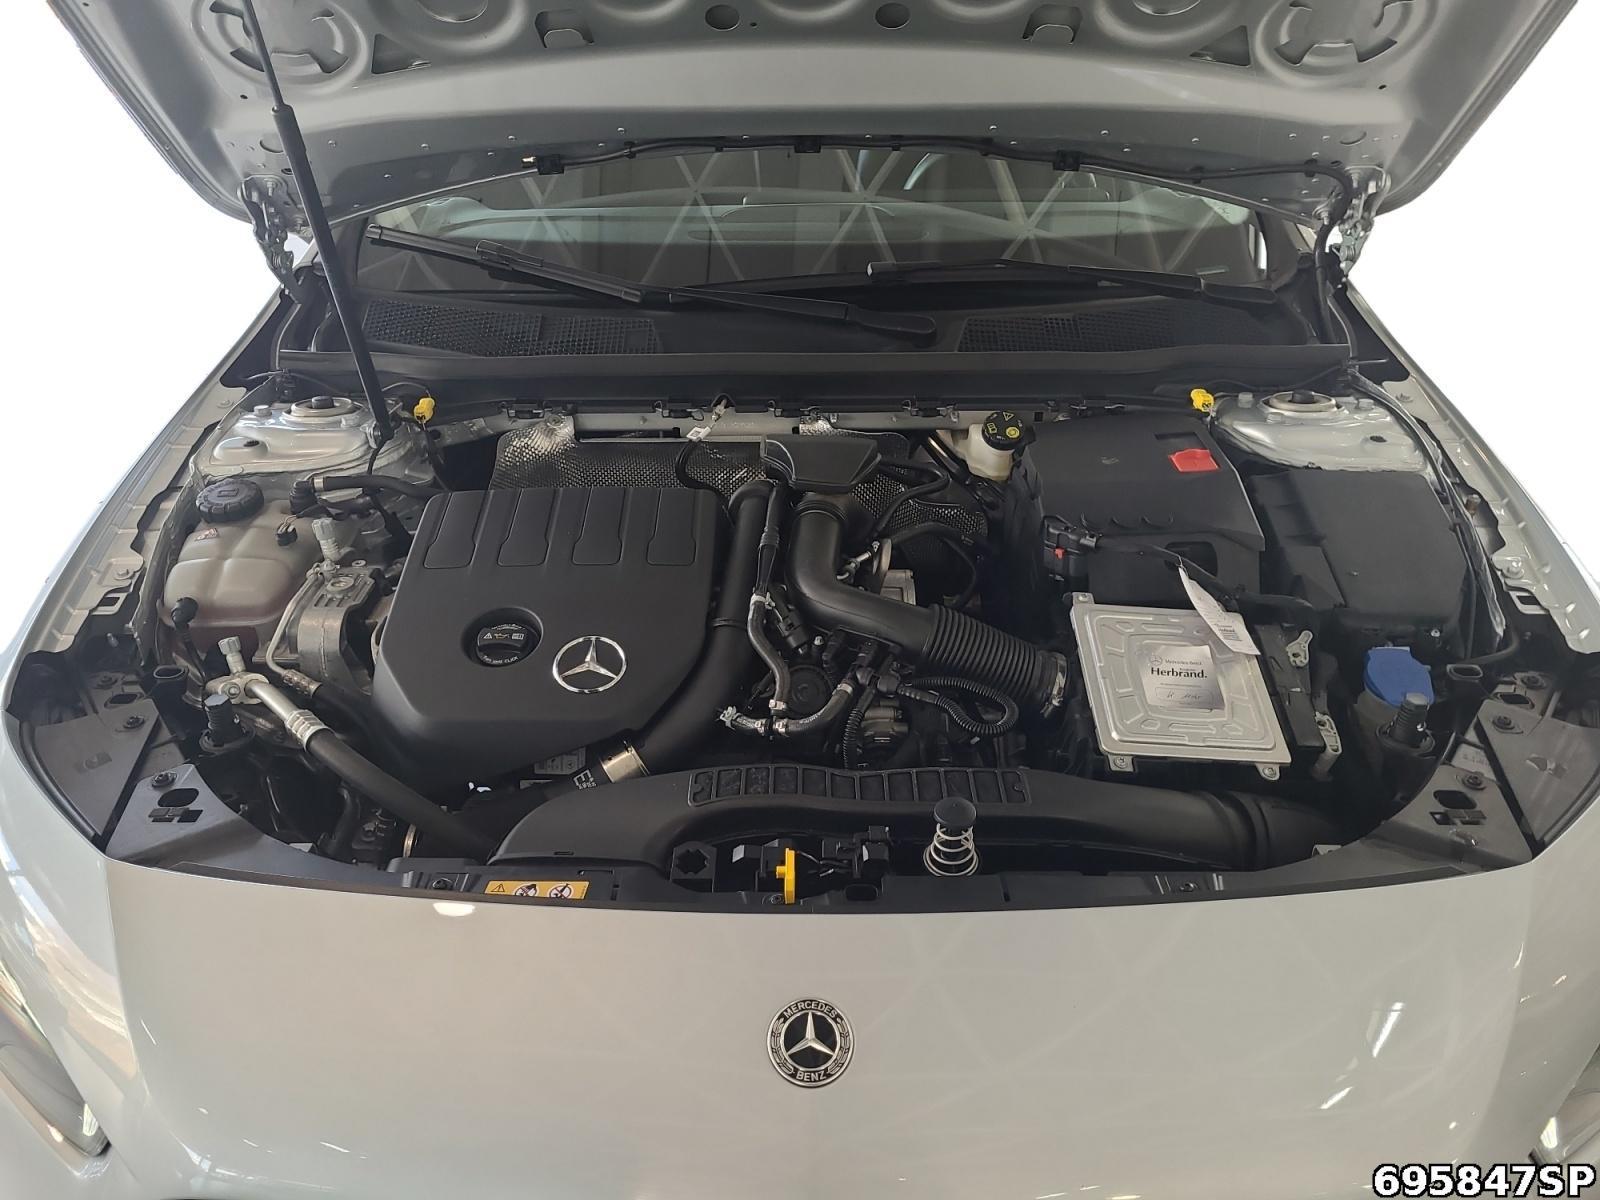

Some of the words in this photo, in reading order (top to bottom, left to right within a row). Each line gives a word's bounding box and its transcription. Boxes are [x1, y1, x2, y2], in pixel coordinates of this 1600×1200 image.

[1151, 667, 1208, 679] Herbrand.
[783, 1001, 837, 1018] MERCEDES
[796, 1070, 827, 1082] BENZ
